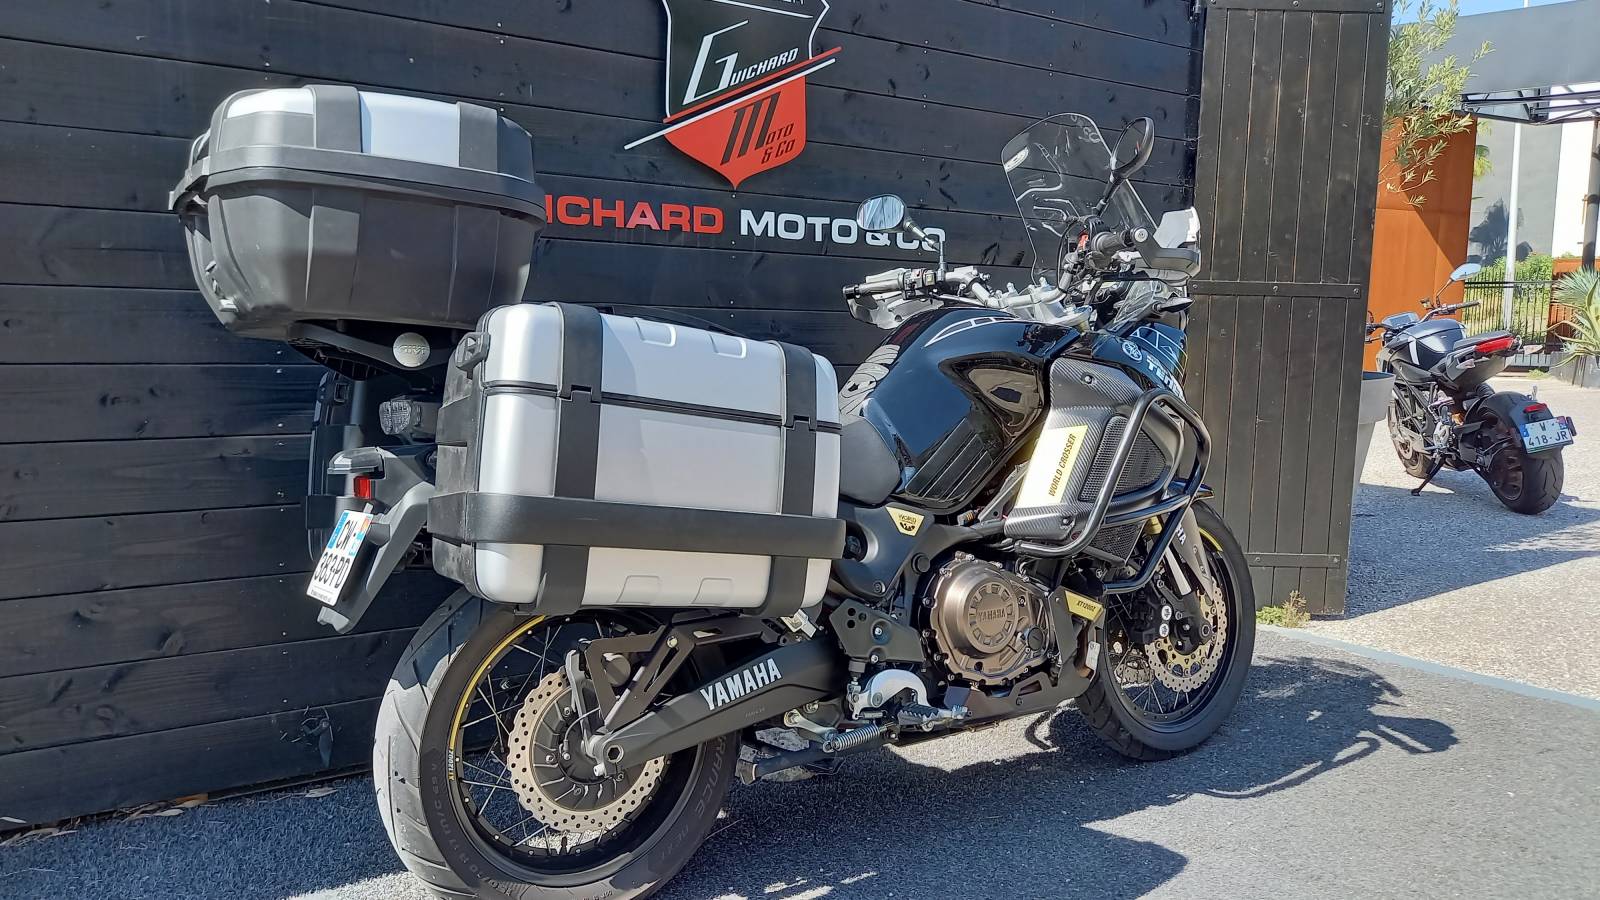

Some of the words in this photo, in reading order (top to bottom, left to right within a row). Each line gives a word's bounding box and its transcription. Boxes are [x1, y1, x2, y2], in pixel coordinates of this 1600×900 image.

[544, 194, 724, 234] ICHARD
[740, 209, 858, 244] MOTO
[1528, 430, 1568, 447] 418-JR
[1048, 468, 1063, 497] WORLD
[1059, 433, 1077, 469] CROSSER
[979, 608, 1006, 621] YAMAHA
[700, 658, 782, 711] YAMAHA
[694, 735, 728, 819] RANCE
